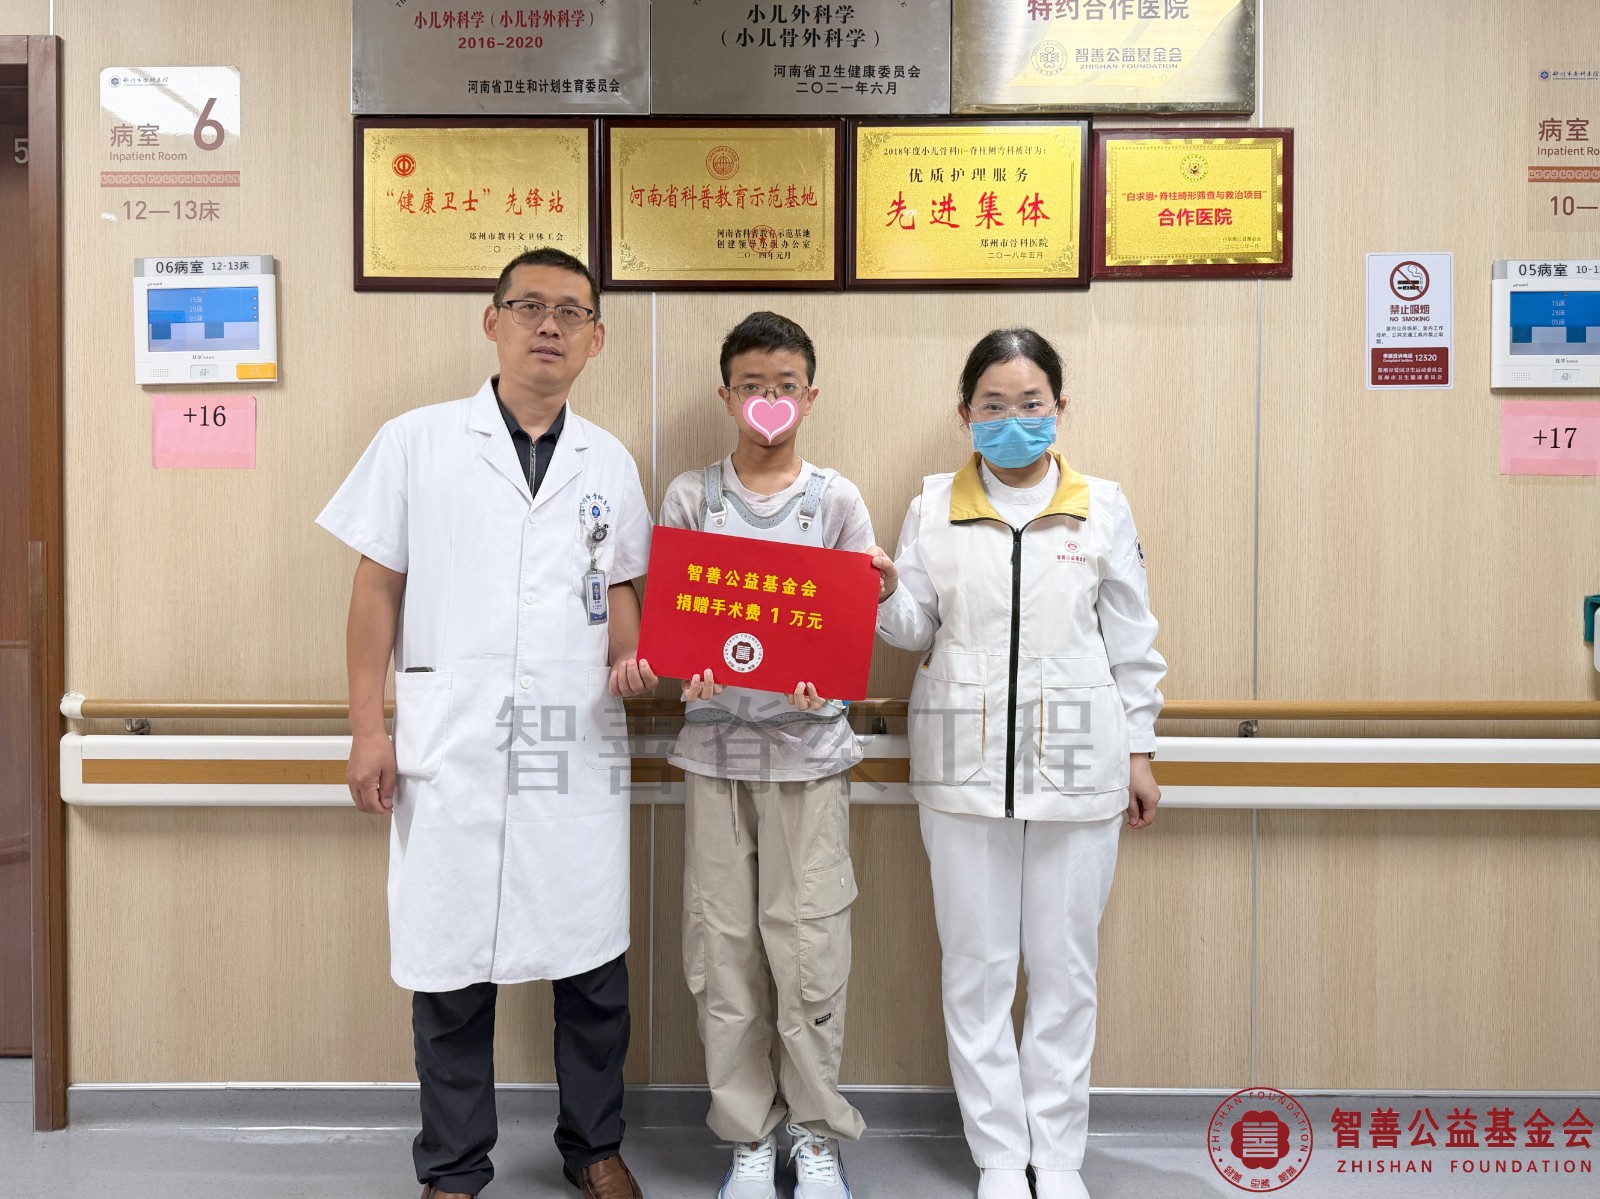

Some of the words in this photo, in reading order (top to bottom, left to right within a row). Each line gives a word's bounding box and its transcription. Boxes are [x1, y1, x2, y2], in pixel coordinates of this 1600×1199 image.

[414, 9, 595, 29] 小儿外科学（小儿骨外科学）
[746, 4, 855, 24] 小儿外科学
[458, 36, 544, 49] 2016-2020
[721, 28, 880, 48] （小儿骨外科学）
[1075, 47, 1182, 62] 智善公益基金会
[773, 64, 921, 79] 河南省卫生健康委员会
[467, 78, 620, 94] 河南省卫生和计划生育委员会
[194, 97, 225, 151] 6
[1538, 117, 1589, 142] 病室
[110, 123, 160, 148] 病室
[109, 151, 156, 163] Inpatient
[158, 151, 188, 161] Room
[1537, 146, 1584, 157] Inpatient
[909, 167, 1029, 183] 优质护理服务
[629, 184, 818, 210] 河南省科普教育示范基地
[885, 190, 1051, 230] 先进集体
[1158, 207, 1233, 226] 合作医院
[468, 231, 564, 241] 郑州市教科文卫体工会
[716, 228, 811, 239] 河南省科普教育示范基地
[717, 239, 811, 249] 创建领导小组办公室
[980, 238, 1049, 248] 郑州市骨科医院
[155, 260, 204, 275] 06病室
[211, 261, 250, 271] 12-13床
[1518, 263, 1568, 277] 05病室
[1389, 304, 1430, 315] 禁止吸烟
[1415, 354, 1438, 362] 12320
[183, 405, 227, 427] +16
[1533, 427, 1578, 449] +17
[687, 563, 817, 598] 智善公益基金会
[676, 593, 761, 622] 捐赠手术费
[770, 607, 779, 624] 1
[789, 609, 823, 630] 万元
